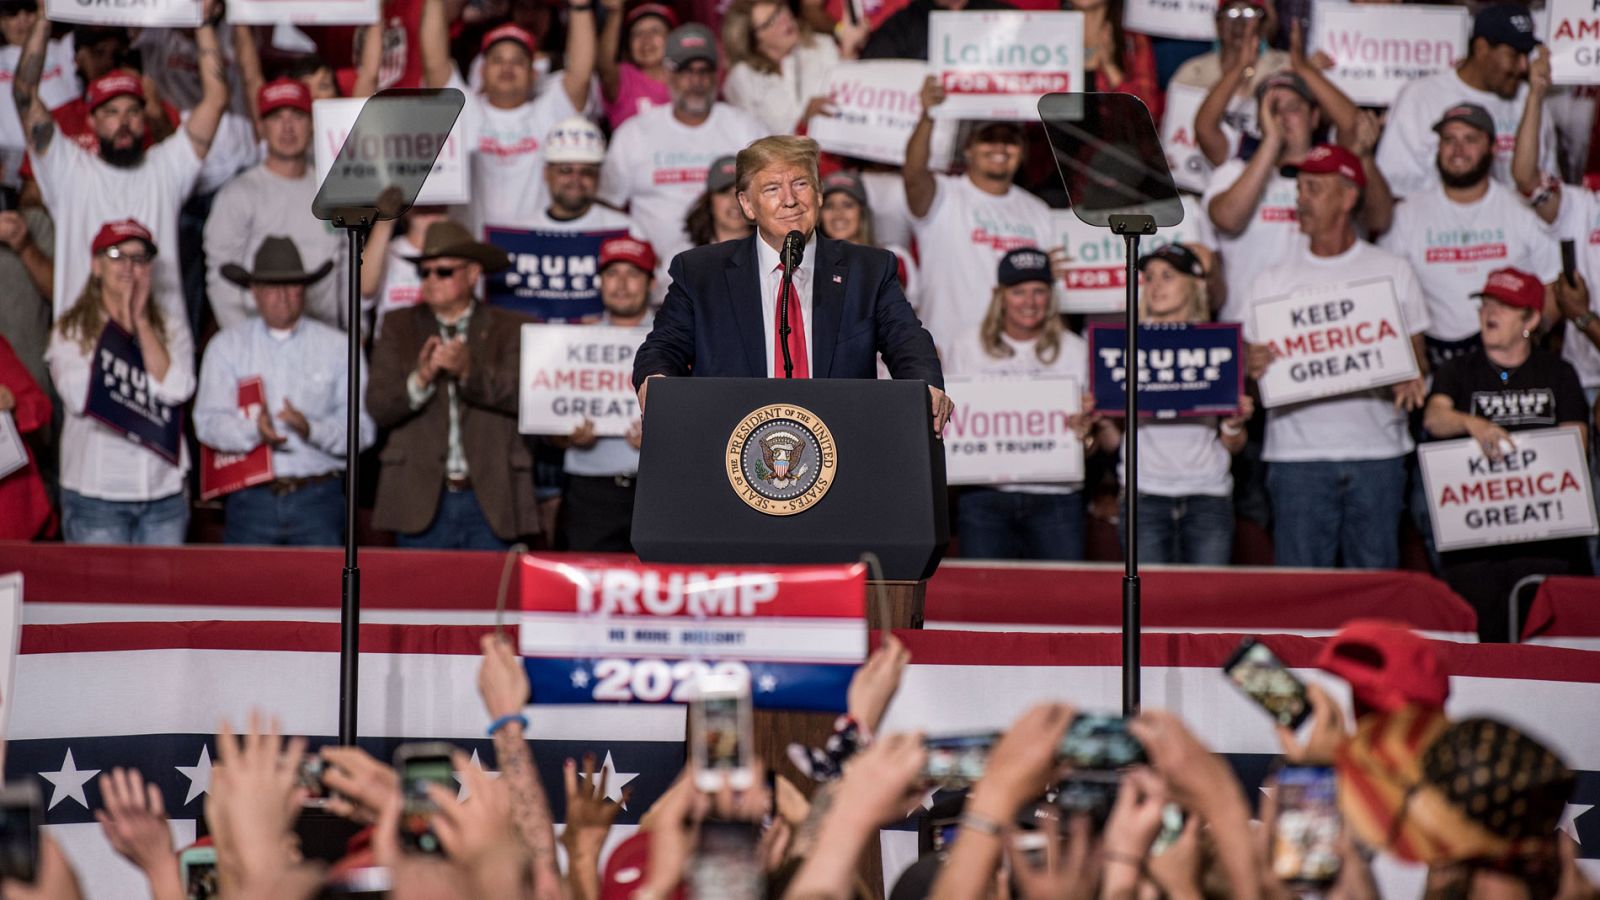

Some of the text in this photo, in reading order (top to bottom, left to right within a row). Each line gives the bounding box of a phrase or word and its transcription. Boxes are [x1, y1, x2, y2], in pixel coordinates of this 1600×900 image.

[943, 33, 1069, 65] Lainos
[1327, 30, 1455, 67] Women
[829, 80, 921, 113] Wome
[945, 74, 1066, 92] FOR TRUMP
[327, 126, 457, 161] Women
[342, 163, 377, 178] FOR
[1062, 231, 1183, 261] Latio
[1427, 228, 1505, 245] Latinos
[508, 253, 598, 276] RUM
[1069, 271, 1110, 287] FOR
[1290, 299, 1355, 329] KEEP
[1267, 319, 1398, 358] AMERICA
[566, 344, 633, 364] KEEP
[1099, 347, 1232, 369] TRUMP
[1289, 347, 1384, 383] GREAT!
[101, 348, 147, 391] TRU
[531, 368, 634, 391] AMERI
[1111, 367, 1220, 382] PENCE
[942, 403, 1069, 438] Women
[730, 407, 834, 511] SEAL OF THE PRESIDENT OF THE UNITED STATES
[951, 440, 1056, 456] FOR TRUMP
[1467, 449, 1538, 476] KEEP
[1439, 469, 1581, 508] AMERICA
[1465, 498, 1564, 530] GREAT!
[575, 568, 780, 616] TRUMP
